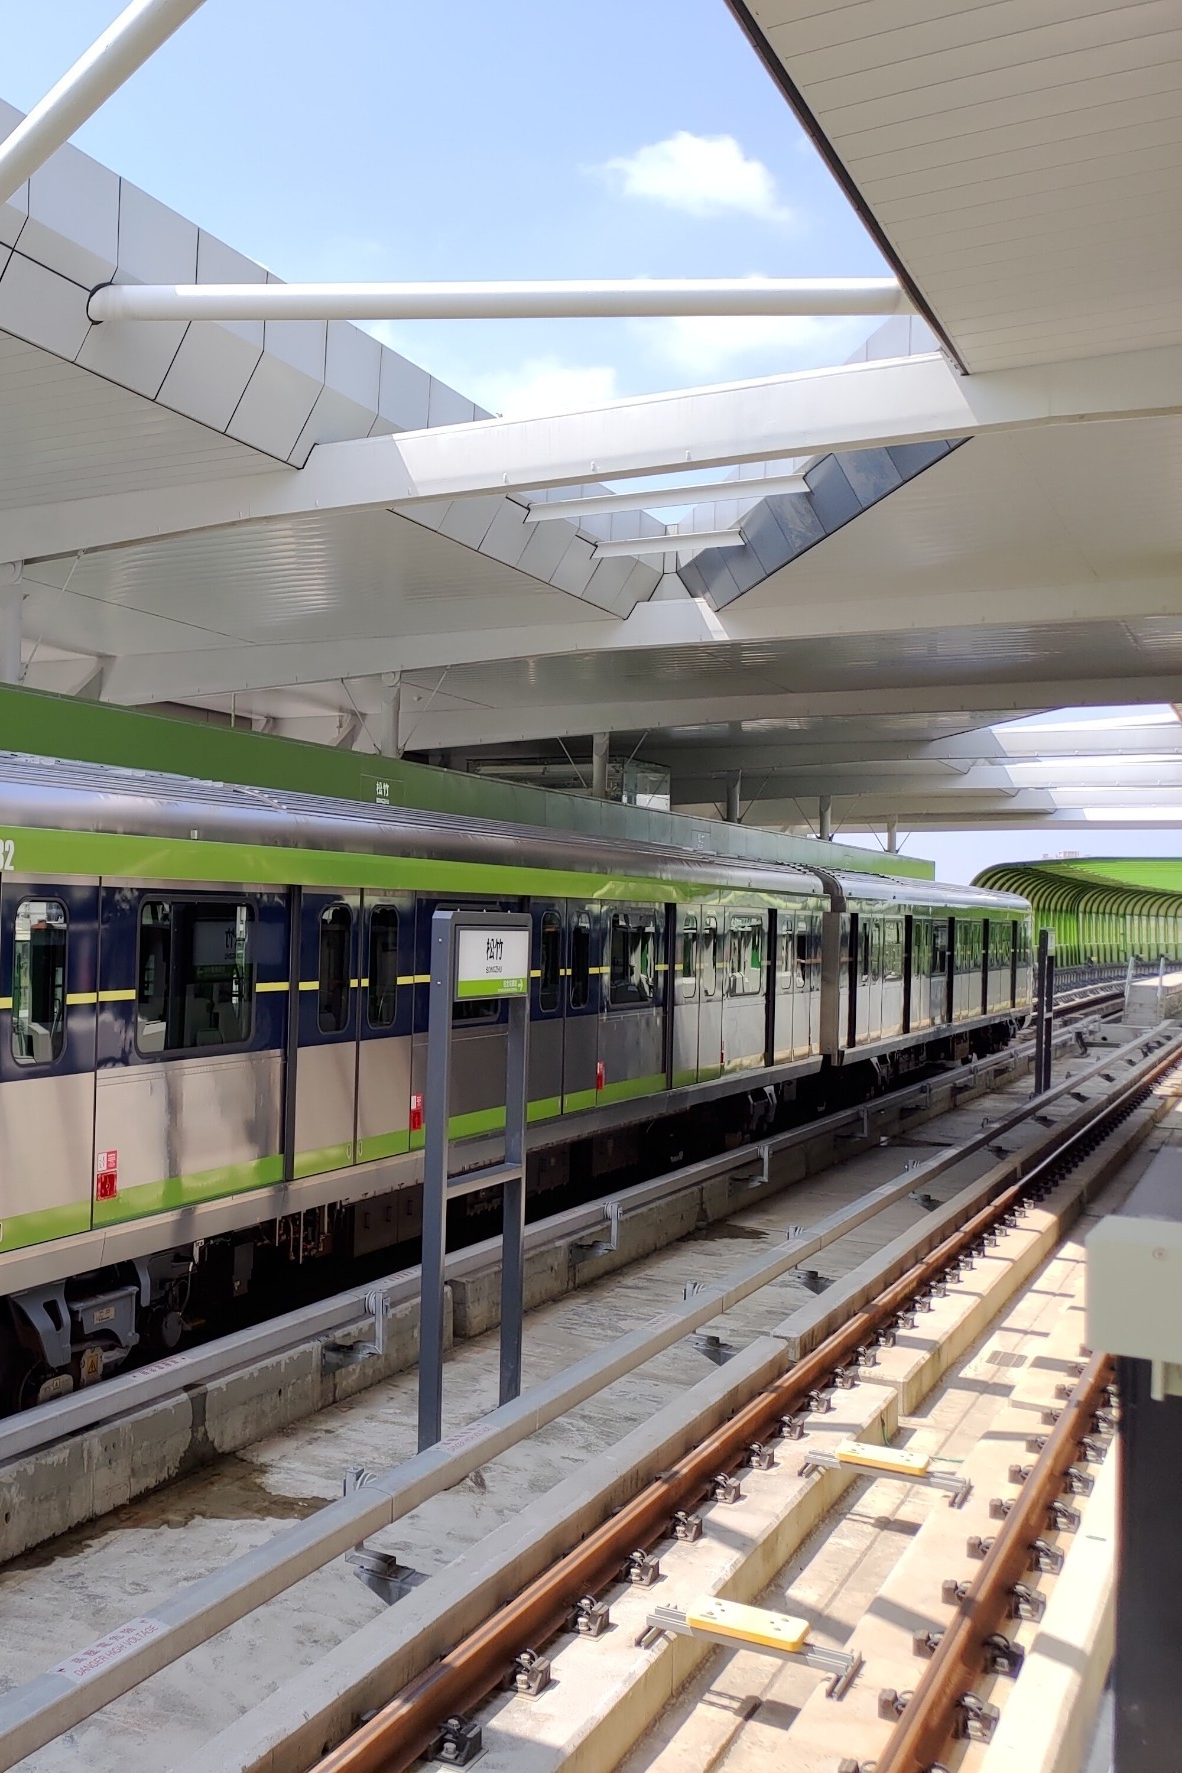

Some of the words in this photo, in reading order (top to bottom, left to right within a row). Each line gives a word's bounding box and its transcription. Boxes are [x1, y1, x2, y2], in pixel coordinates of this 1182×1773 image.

[486, 938, 504, 960] 松竹
[73, 1655, 109, 1677] DANGER
[105, 1643, 127, 1658] HIGH
[124, 1624, 159, 1646] VOLTAGE
